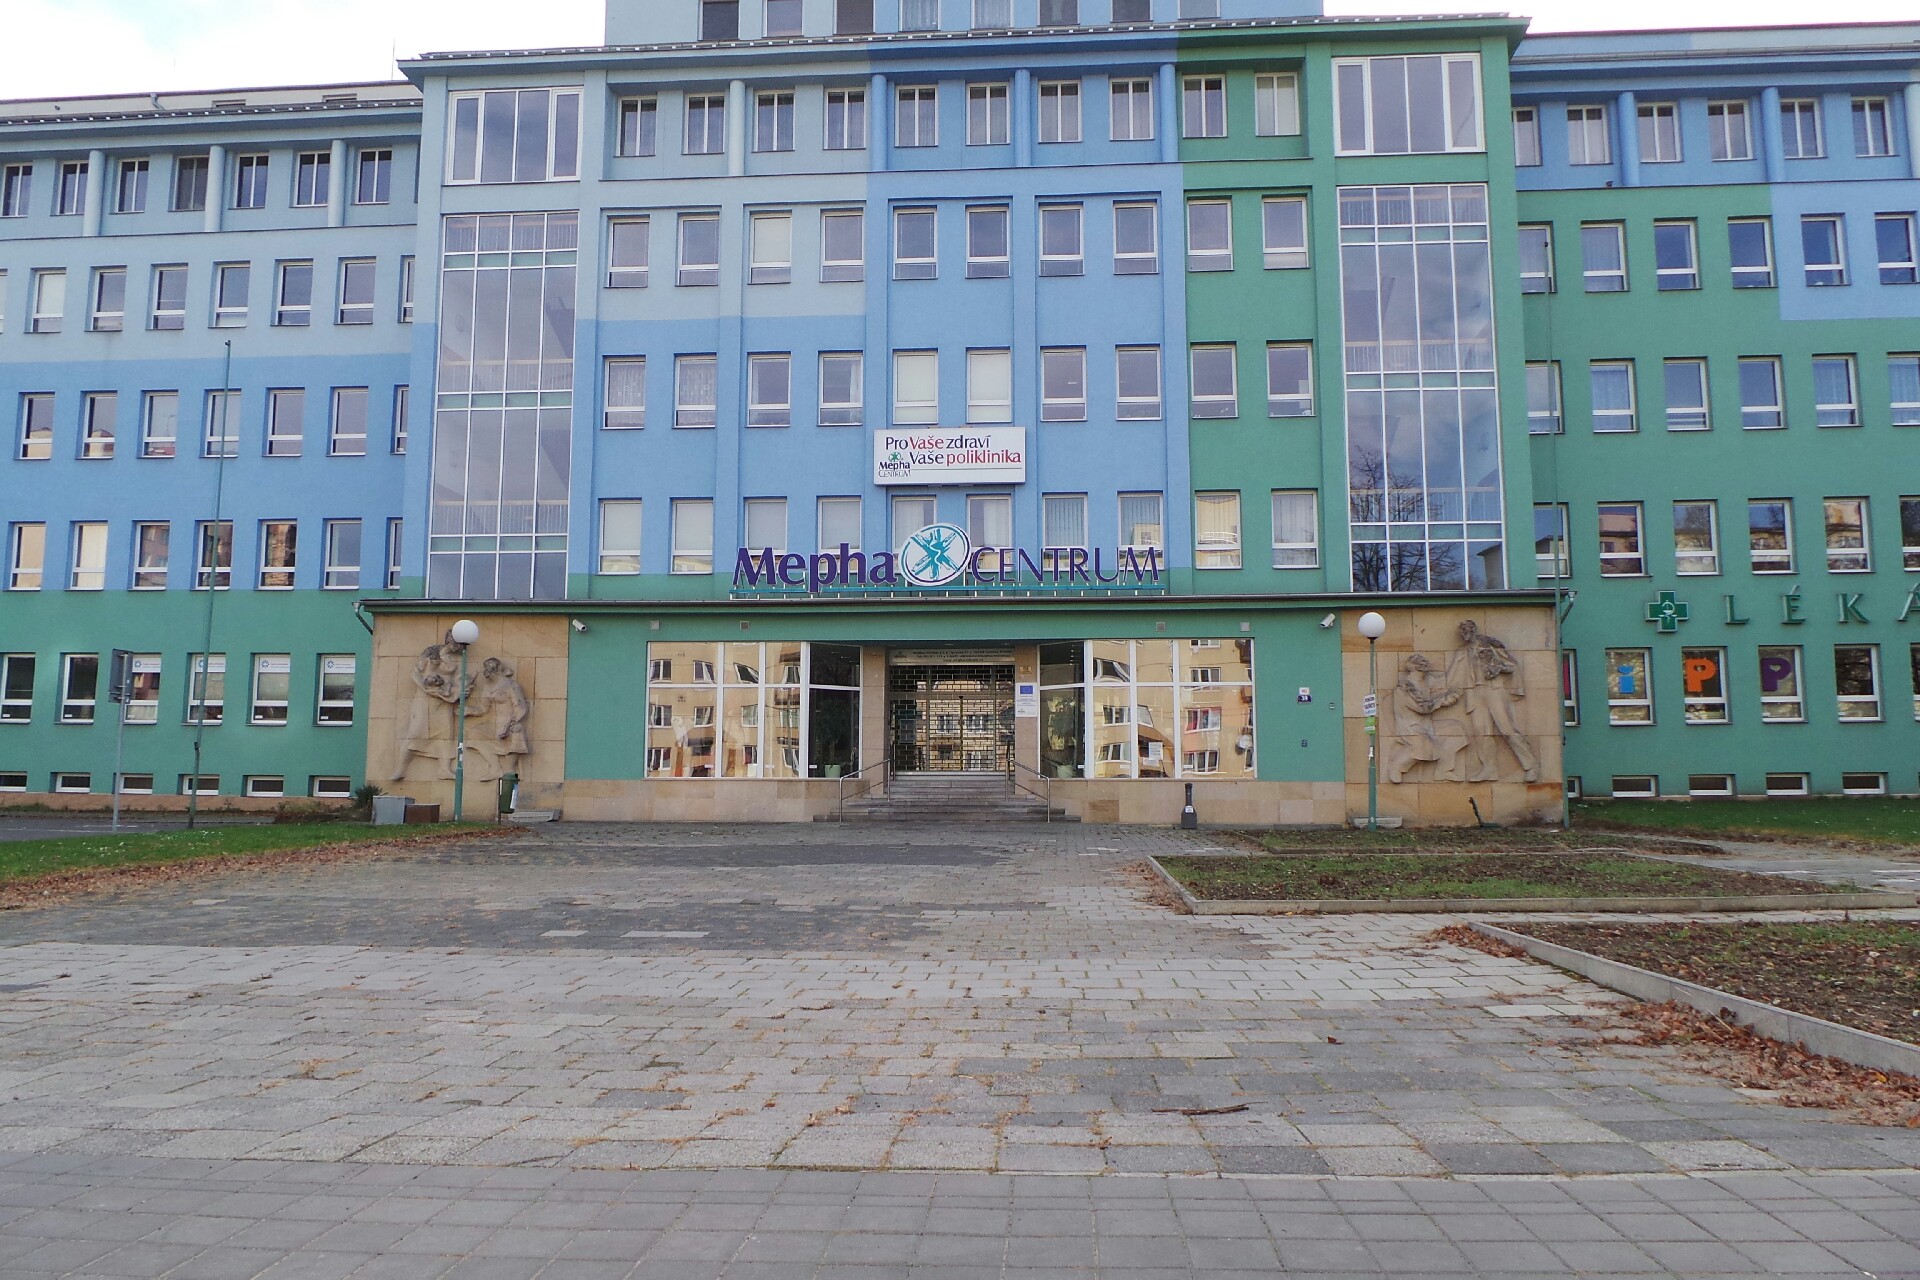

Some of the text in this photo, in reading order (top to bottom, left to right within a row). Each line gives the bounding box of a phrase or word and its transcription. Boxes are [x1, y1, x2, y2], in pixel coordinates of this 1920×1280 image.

[885, 434, 992, 450] Pro Vaše zdraví
[878, 461, 911, 471] Mepha
[909, 449, 1021, 467] Vaše poliklinika
[732, 542, 1159, 593] Mepha CENTRUM
